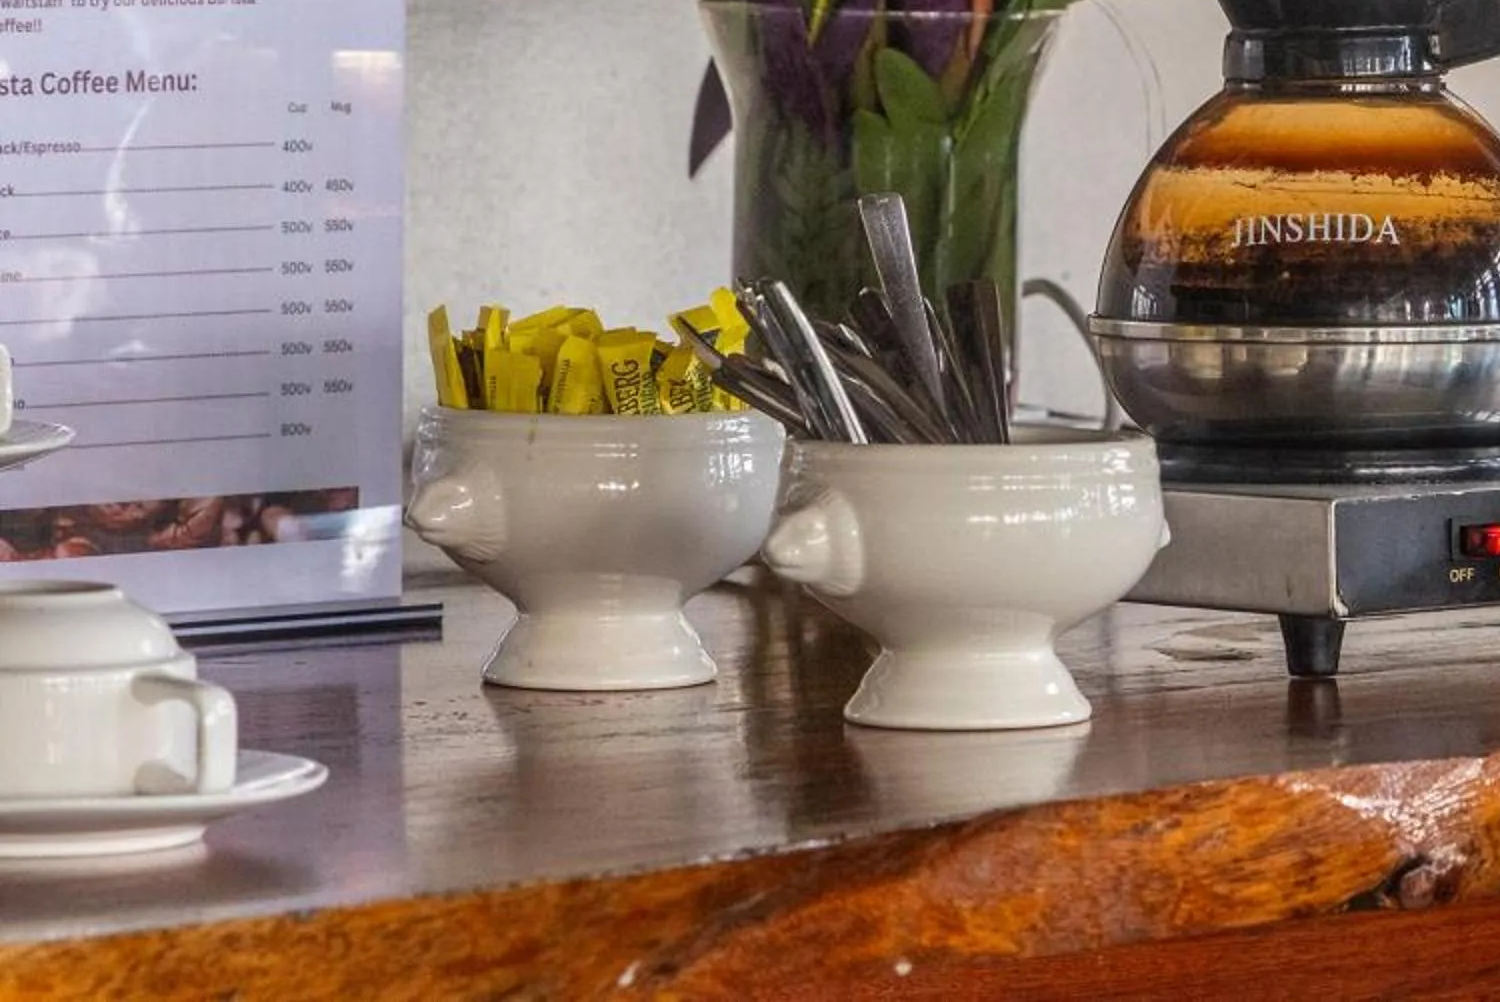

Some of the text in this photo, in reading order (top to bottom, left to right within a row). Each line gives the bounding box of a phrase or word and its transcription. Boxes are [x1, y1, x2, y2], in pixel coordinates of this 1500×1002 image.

[40, 70, 119, 95] Coffee
[126, 69, 197, 93] Menu:
[282, 139, 313, 152] 400v
[282, 180, 313, 193] 400v
[281, 221, 313, 234] 500v
[324, 218, 354, 232] 550v
[1230, 213, 1400, 248] JINSHIDA
[281, 261, 313, 275] 500v
[281, 301, 312, 315] 500v
[281, 339, 354, 355] 500v 550v
[280, 382, 312, 396] 500v
[323, 379, 353, 393] 550v
[1449, 567, 1475, 583] OFF
